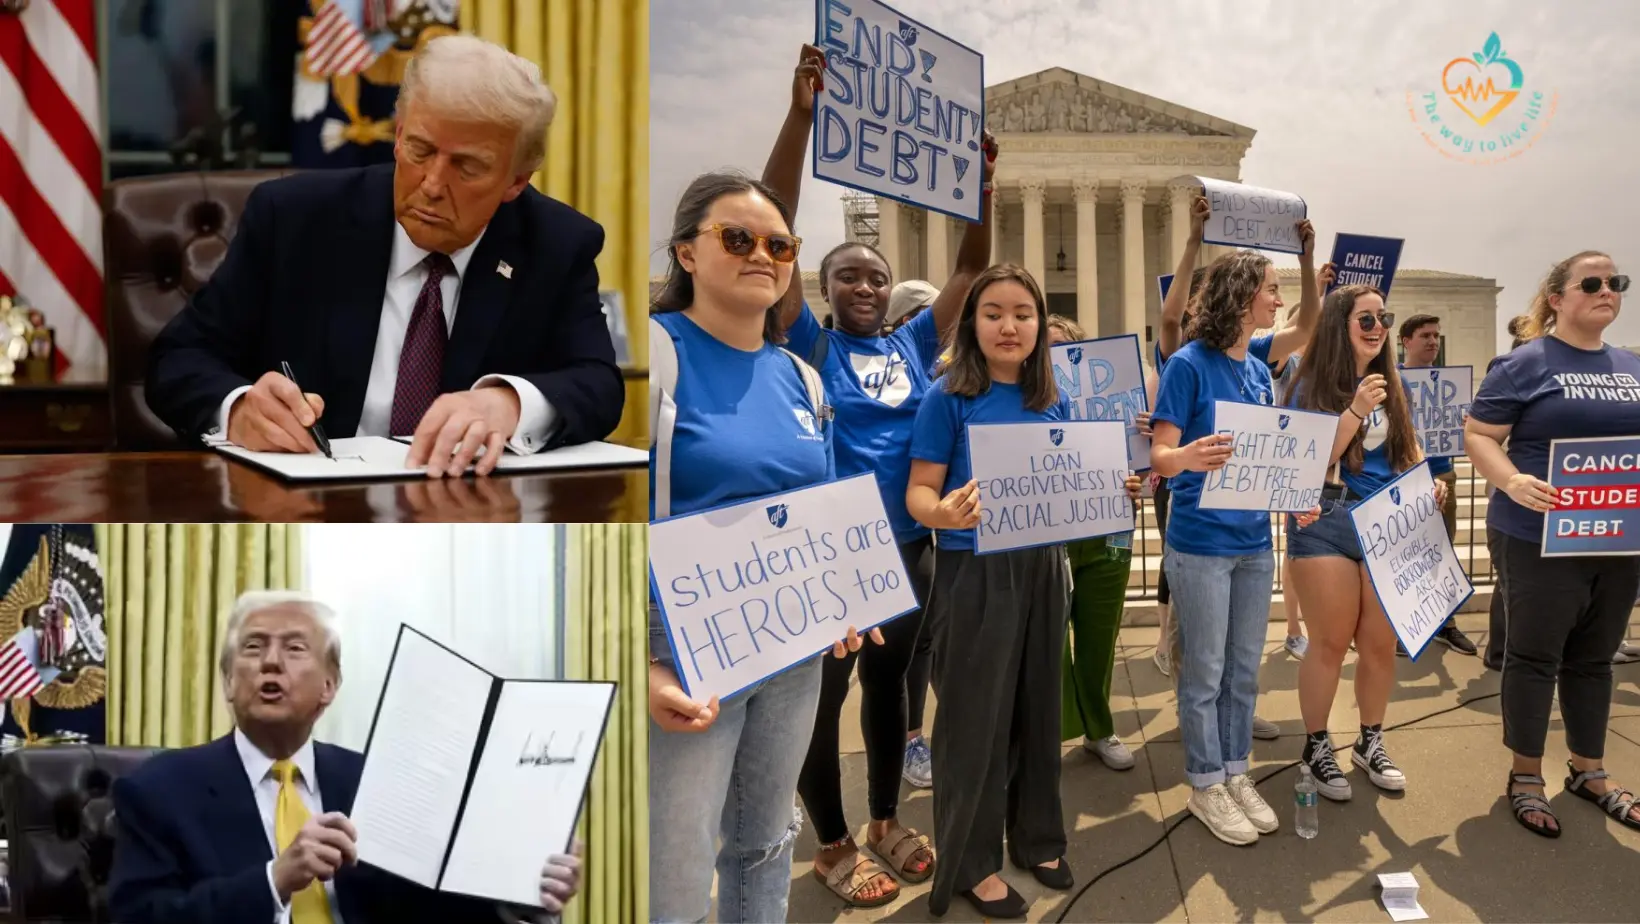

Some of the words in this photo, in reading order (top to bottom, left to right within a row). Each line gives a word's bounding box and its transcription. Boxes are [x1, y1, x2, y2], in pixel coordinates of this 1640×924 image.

[824, 49, 980, 151] STUDENT!
[819, 104, 969, 200] DEBT!
[1212, 191, 1245, 212] END
[1223, 215, 1266, 240] DEBT
[1344, 252, 1384, 270] CANCEL
[1337, 270, 1384, 288] STUDENT
[863, 350, 908, 400] aft
[1052, 357, 1115, 399] ND
[1553, 372, 1616, 387] YOUNG
[1564, 385, 1640, 402] INVINCI
[1272, 435, 1298, 460] FOR
[1303, 438, 1316, 460] A
[1030, 451, 1081, 474] LOAN
[977, 470, 1106, 501] FORGIVENESS
[1112, 469, 1126, 490] IS
[1207, 463, 1267, 493] DEBT
[1263, 465, 1300, 491] FREE
[1268, 488, 1321, 510] FUTURE
[1560, 488, 1640, 506] STUDE
[979, 501, 1060, 537] RACIAL
[1064, 494, 1131, 525] JUSTICE
[1557, 518, 1623, 536] DEBT
[671, 528, 838, 608] students
[845, 518, 892, 553] are
[1390, 530, 1431, 574] ELIGIBLE
[1394, 543, 1443, 596] BORROWERS
[1415, 573, 1437, 601] ARE
[1401, 566, 1464, 640] WAITING!
[680, 569, 848, 681] HEROES
[852, 568, 900, 602] too
